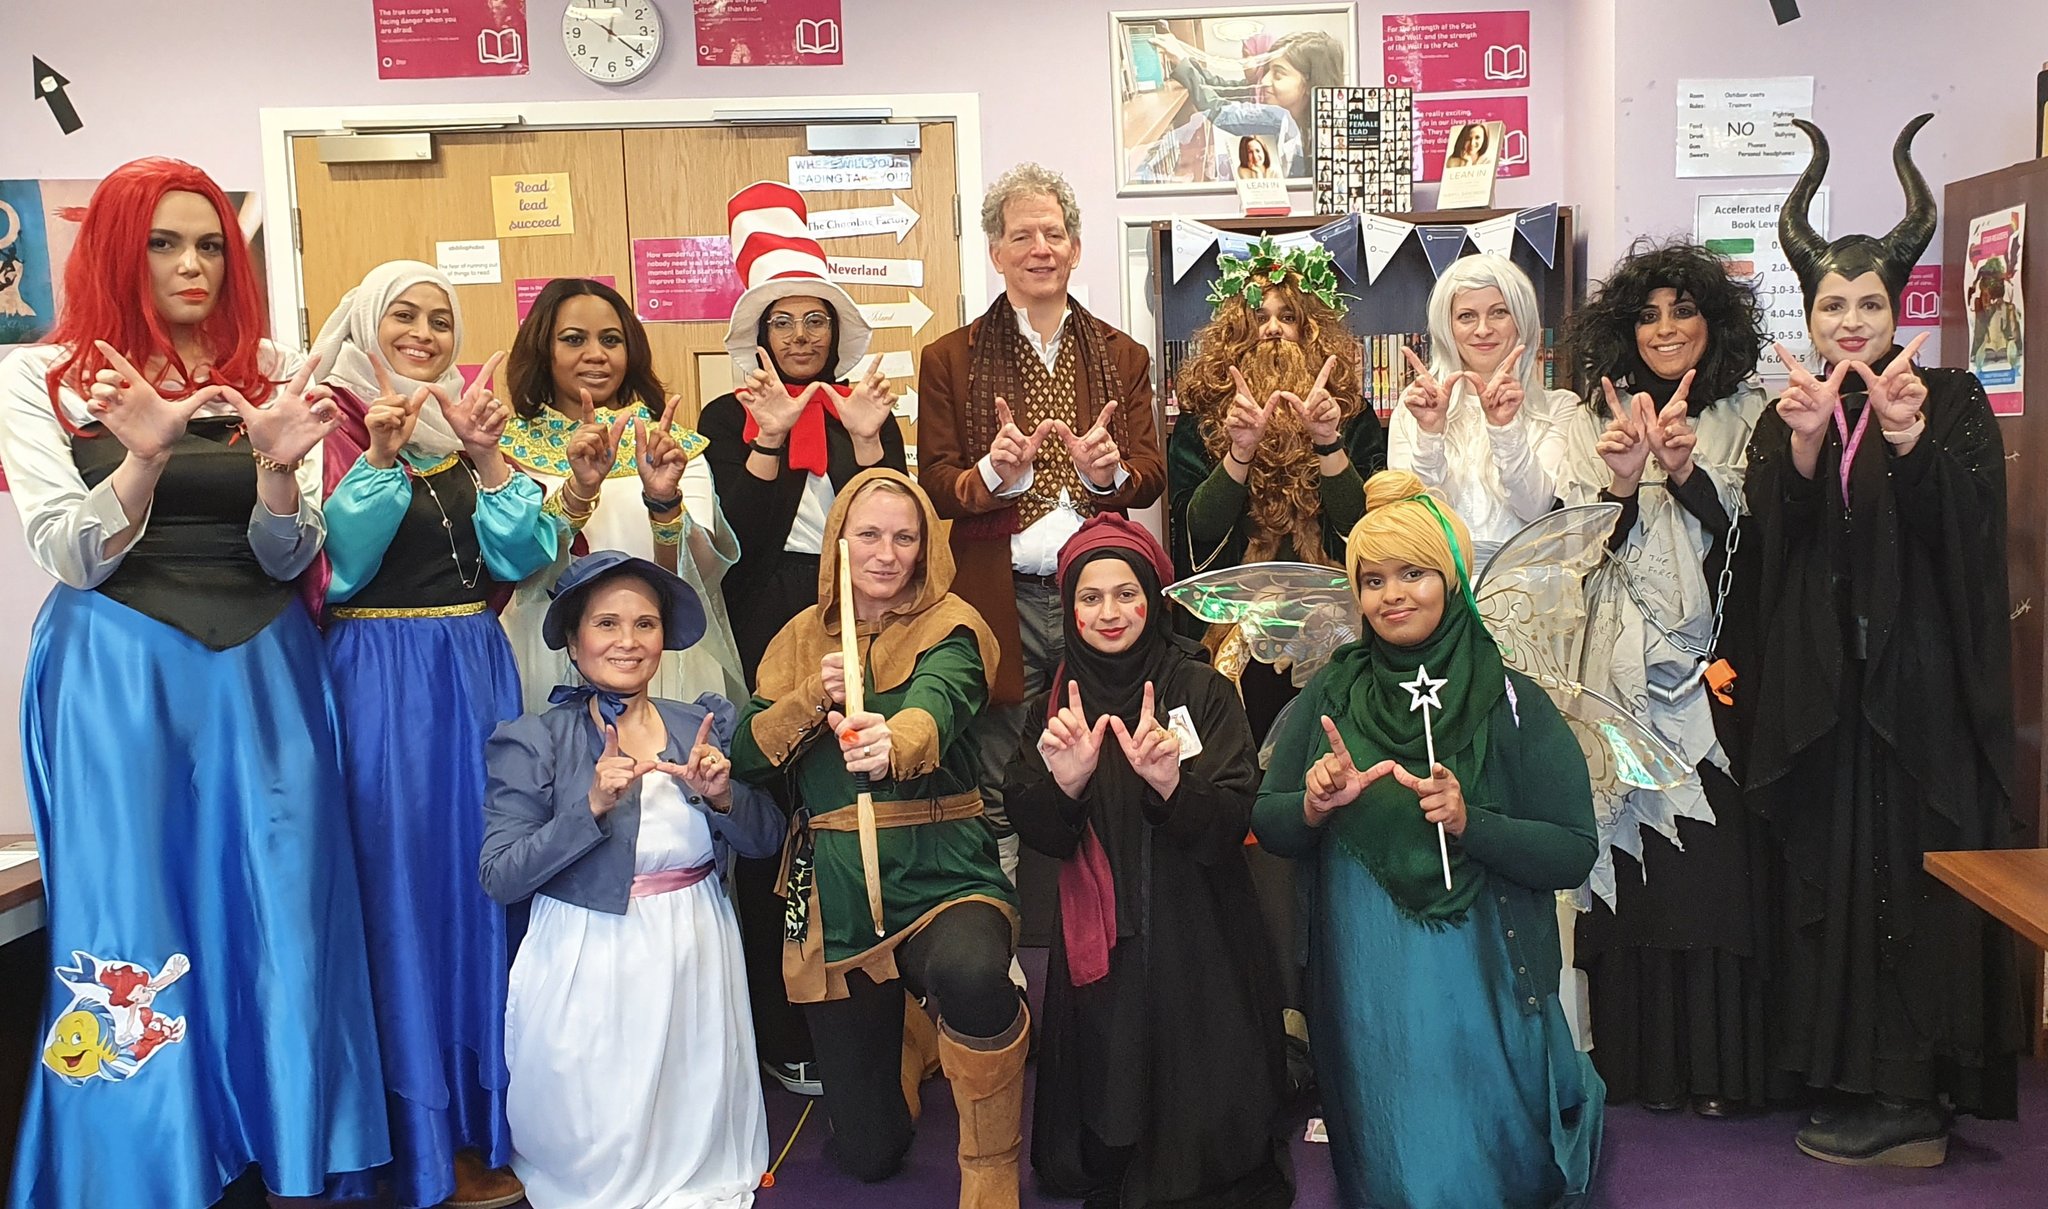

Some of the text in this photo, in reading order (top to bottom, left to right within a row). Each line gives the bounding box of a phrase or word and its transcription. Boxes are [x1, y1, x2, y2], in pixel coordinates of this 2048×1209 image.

[407, 8, 434, 16] courage
[634, 9, 644, 20] 2
[400, 18, 424, 26] danger
[572, 27, 581, 38] 9
[639, 26, 648, 36] 3
[1412, 24, 1440, 33] strength
[1460, 22, 1476, 30] Pack
[1437, 32, 1448, 40] the
[1450, 32, 1478, 40] strength
[577, 44, 586, 56] 8
[590, 56, 599, 68] 7
[608, 61, 617, 72] 6
[624, 56, 634, 67] 5
[1425, 110, 1445, 118] really
[1348, 120, 1379, 128] FEMALE
[1728, 122, 1755, 136] NO
[1762, 150, 1795, 158] headphones
[798, 173, 843, 184] EADING
[846, 173, 876, 182] TAK
[1450, 169, 1486, 180] LEAN IN
[514, 180, 550, 193] Read
[1246, 182, 1269, 190] LEAN
[519, 198, 548, 211] lead
[1714, 204, 1771, 214] Accelerated
[508, 214, 561, 231] succeed
[808, 216, 910, 231] The Chocolate Factory
[1732, 220, 1779, 229] Book Leve
[646, 251, 660, 259] How
[646, 260, 670, 268] nobody
[828, 262, 887, 276] Neverland
[454, 270, 470, 278] things
[675, 268, 696, 276] before
[648, 278, 674, 287] improve
[868, 312, 895, 322] Island
[1770, 309, 1803, 318] 4.0-4.9
[1771, 331, 1802, 340] 5.0-5.9
